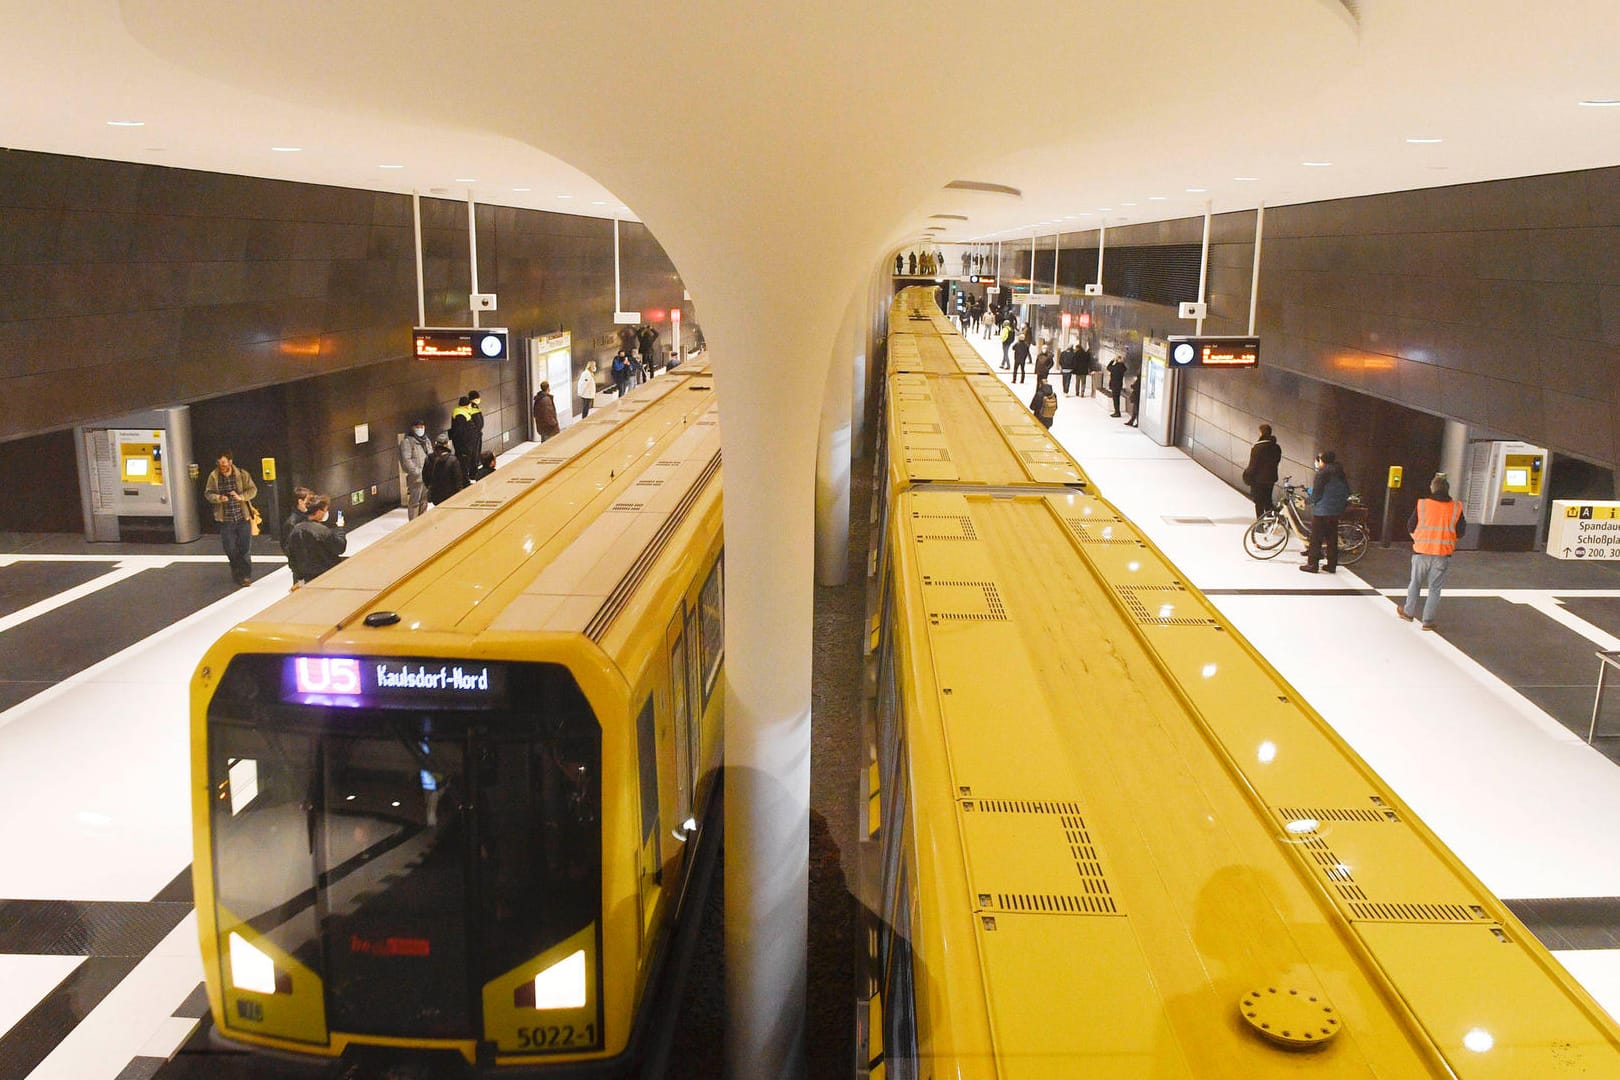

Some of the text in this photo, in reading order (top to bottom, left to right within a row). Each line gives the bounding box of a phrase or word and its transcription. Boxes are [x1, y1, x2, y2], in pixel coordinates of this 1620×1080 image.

[1582, 507, 1590, 518] A
[1588, 548, 1606, 558] 200,
[302, 657, 358, 690] U5
[376, 664, 488, 690] Kaulsdorf-Nord
[518, 1023, 595, 1048] 5022-1
